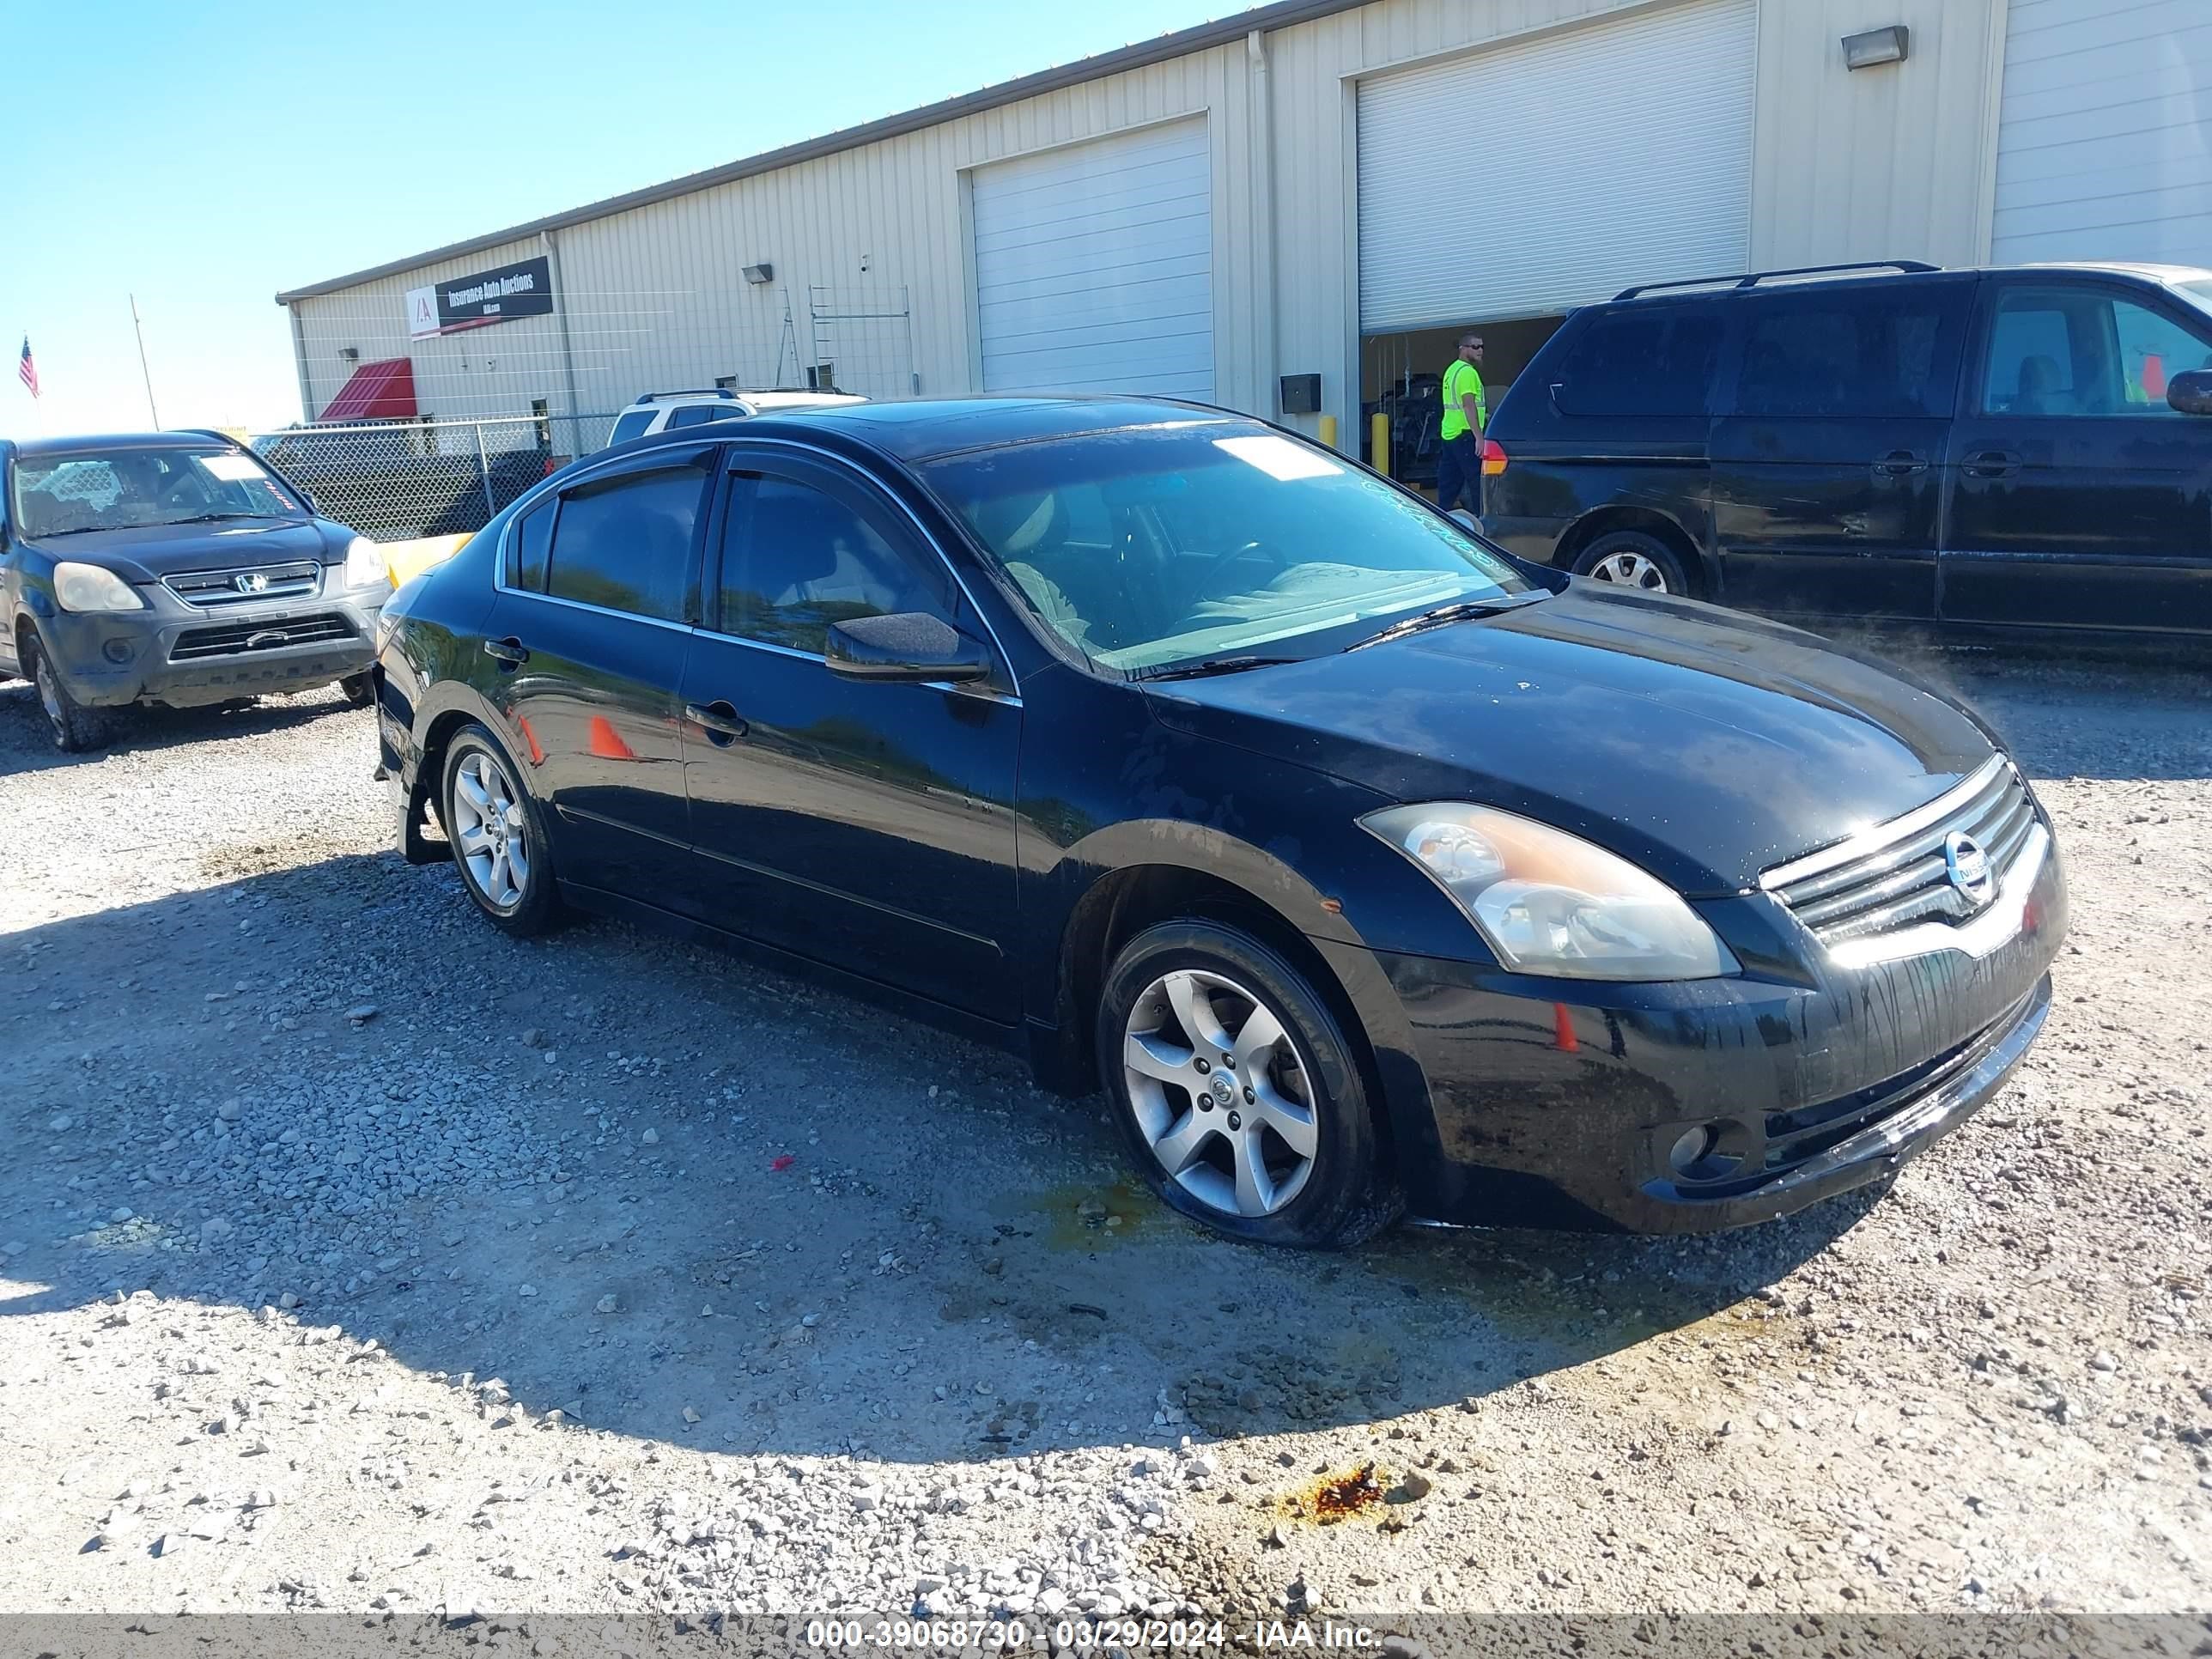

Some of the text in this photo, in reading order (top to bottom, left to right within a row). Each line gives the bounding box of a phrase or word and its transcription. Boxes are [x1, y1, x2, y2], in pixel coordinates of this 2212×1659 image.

[448, 273, 533, 308] Insurance Auto Auctions
